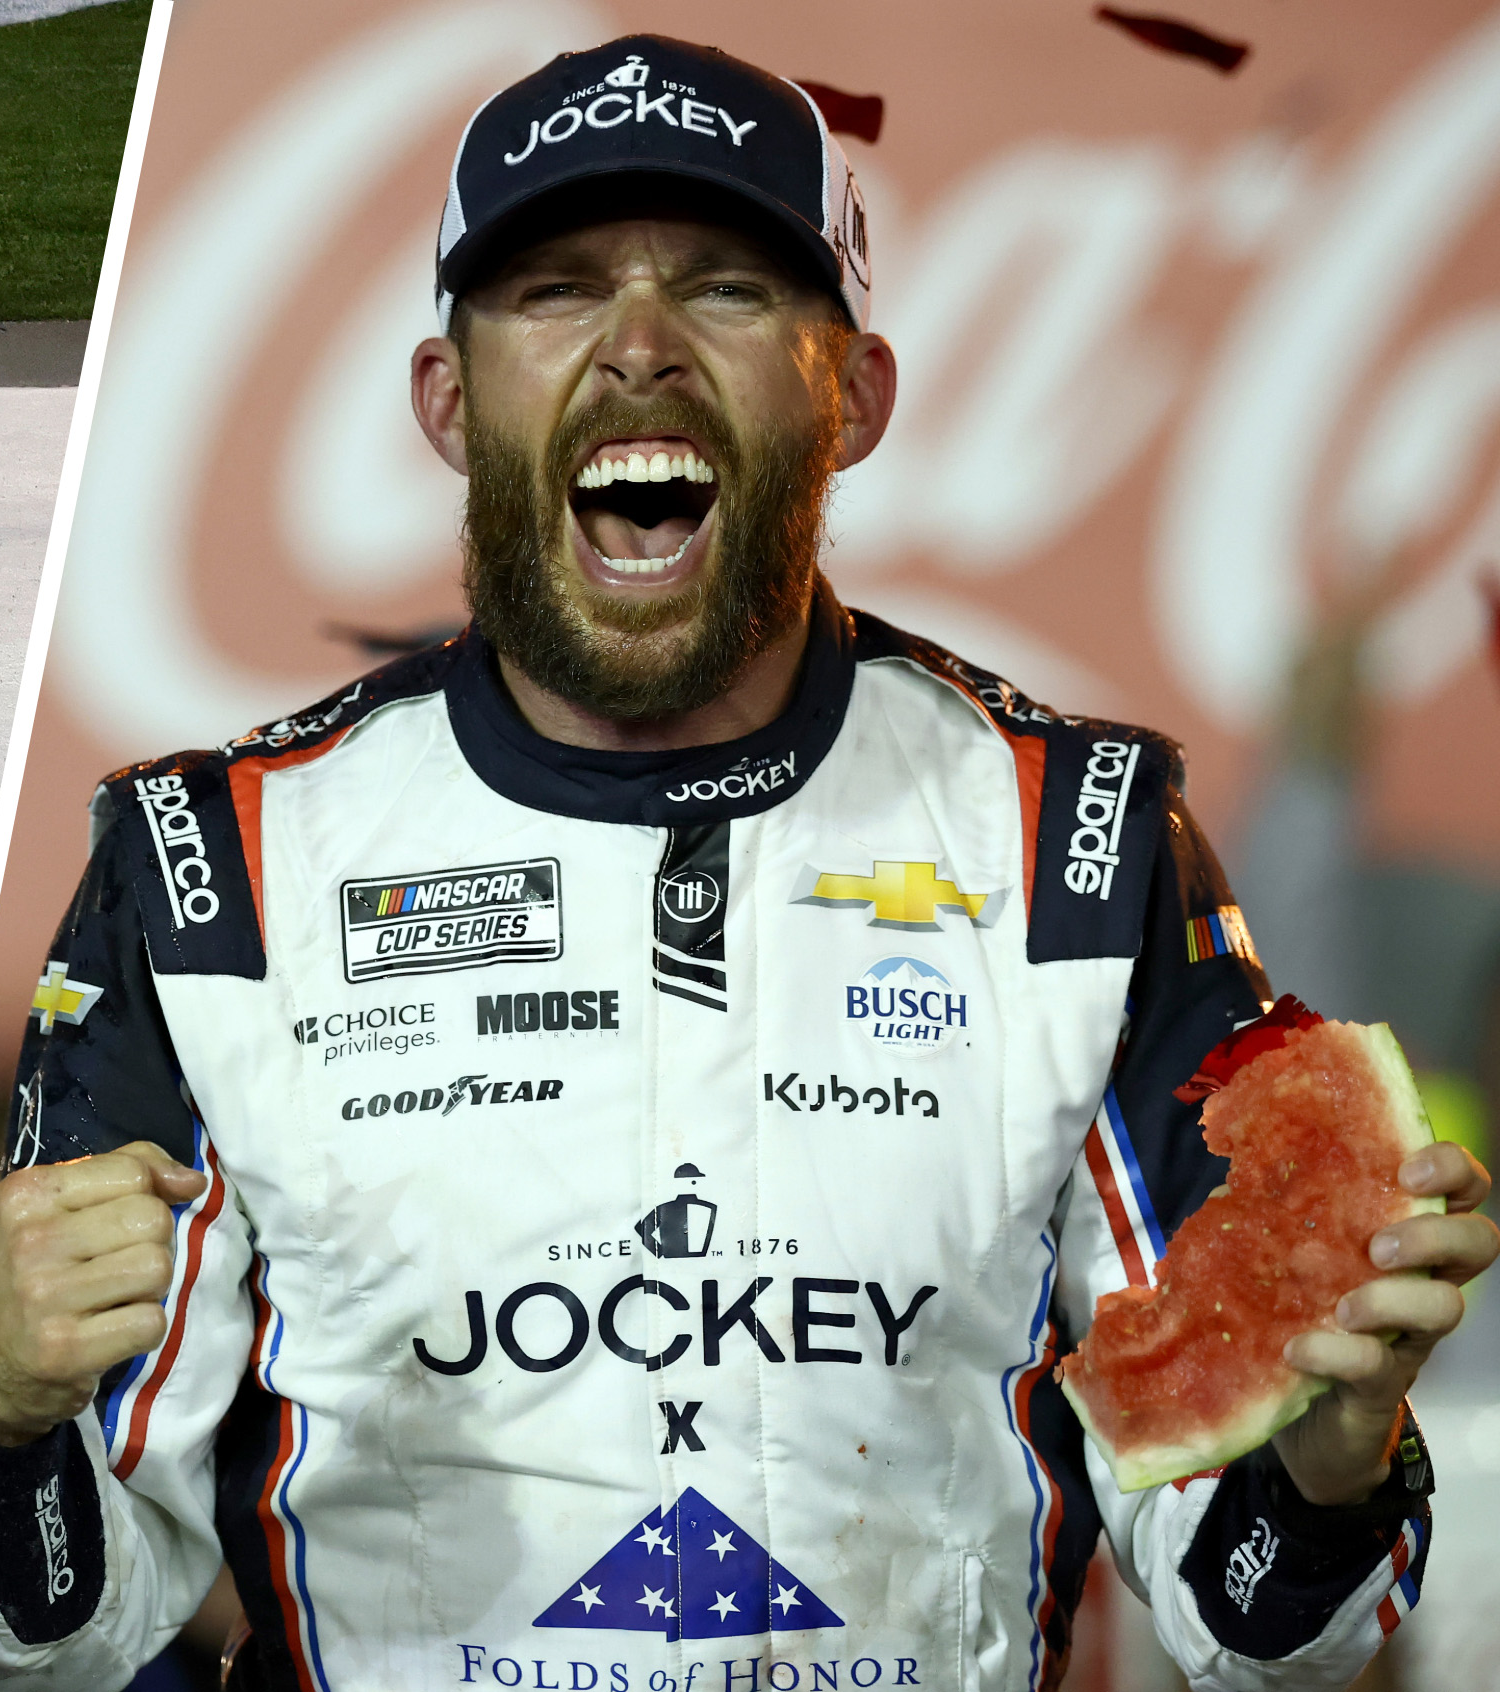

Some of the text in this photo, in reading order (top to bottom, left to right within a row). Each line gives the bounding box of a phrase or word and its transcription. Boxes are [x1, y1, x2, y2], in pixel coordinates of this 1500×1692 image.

[562, 79, 696, 105] SINCE 1876
[503, 90, 758, 166] JOCKEY
[666, 751, 798, 801] JOCKEY
[1064, 740, 1141, 901] sparco
[135, 773, 220, 931] sparco
[413, 873, 526, 911] NASCAR
[376, 914, 529, 955] CUP SERIES
[324, 1003, 436, 1037] CHOICE
[476, 990, 620, 1035] MOOSE
[845, 985, 968, 1028] BUSCH
[476, 1031, 621, 1043] FRATERNITY
[873, 1022, 945, 1041] LIGHT
[763, 1072, 940, 1119] Kubota
[547, 1239, 632, 1261] SINCE
[737, 1238, 799, 1256] 1876
[412, 1273, 939, 1377] JOCKEY
[659, 1401, 706, 1455] X
[456, 1643, 921, 1692] FOLDS of HONOR
